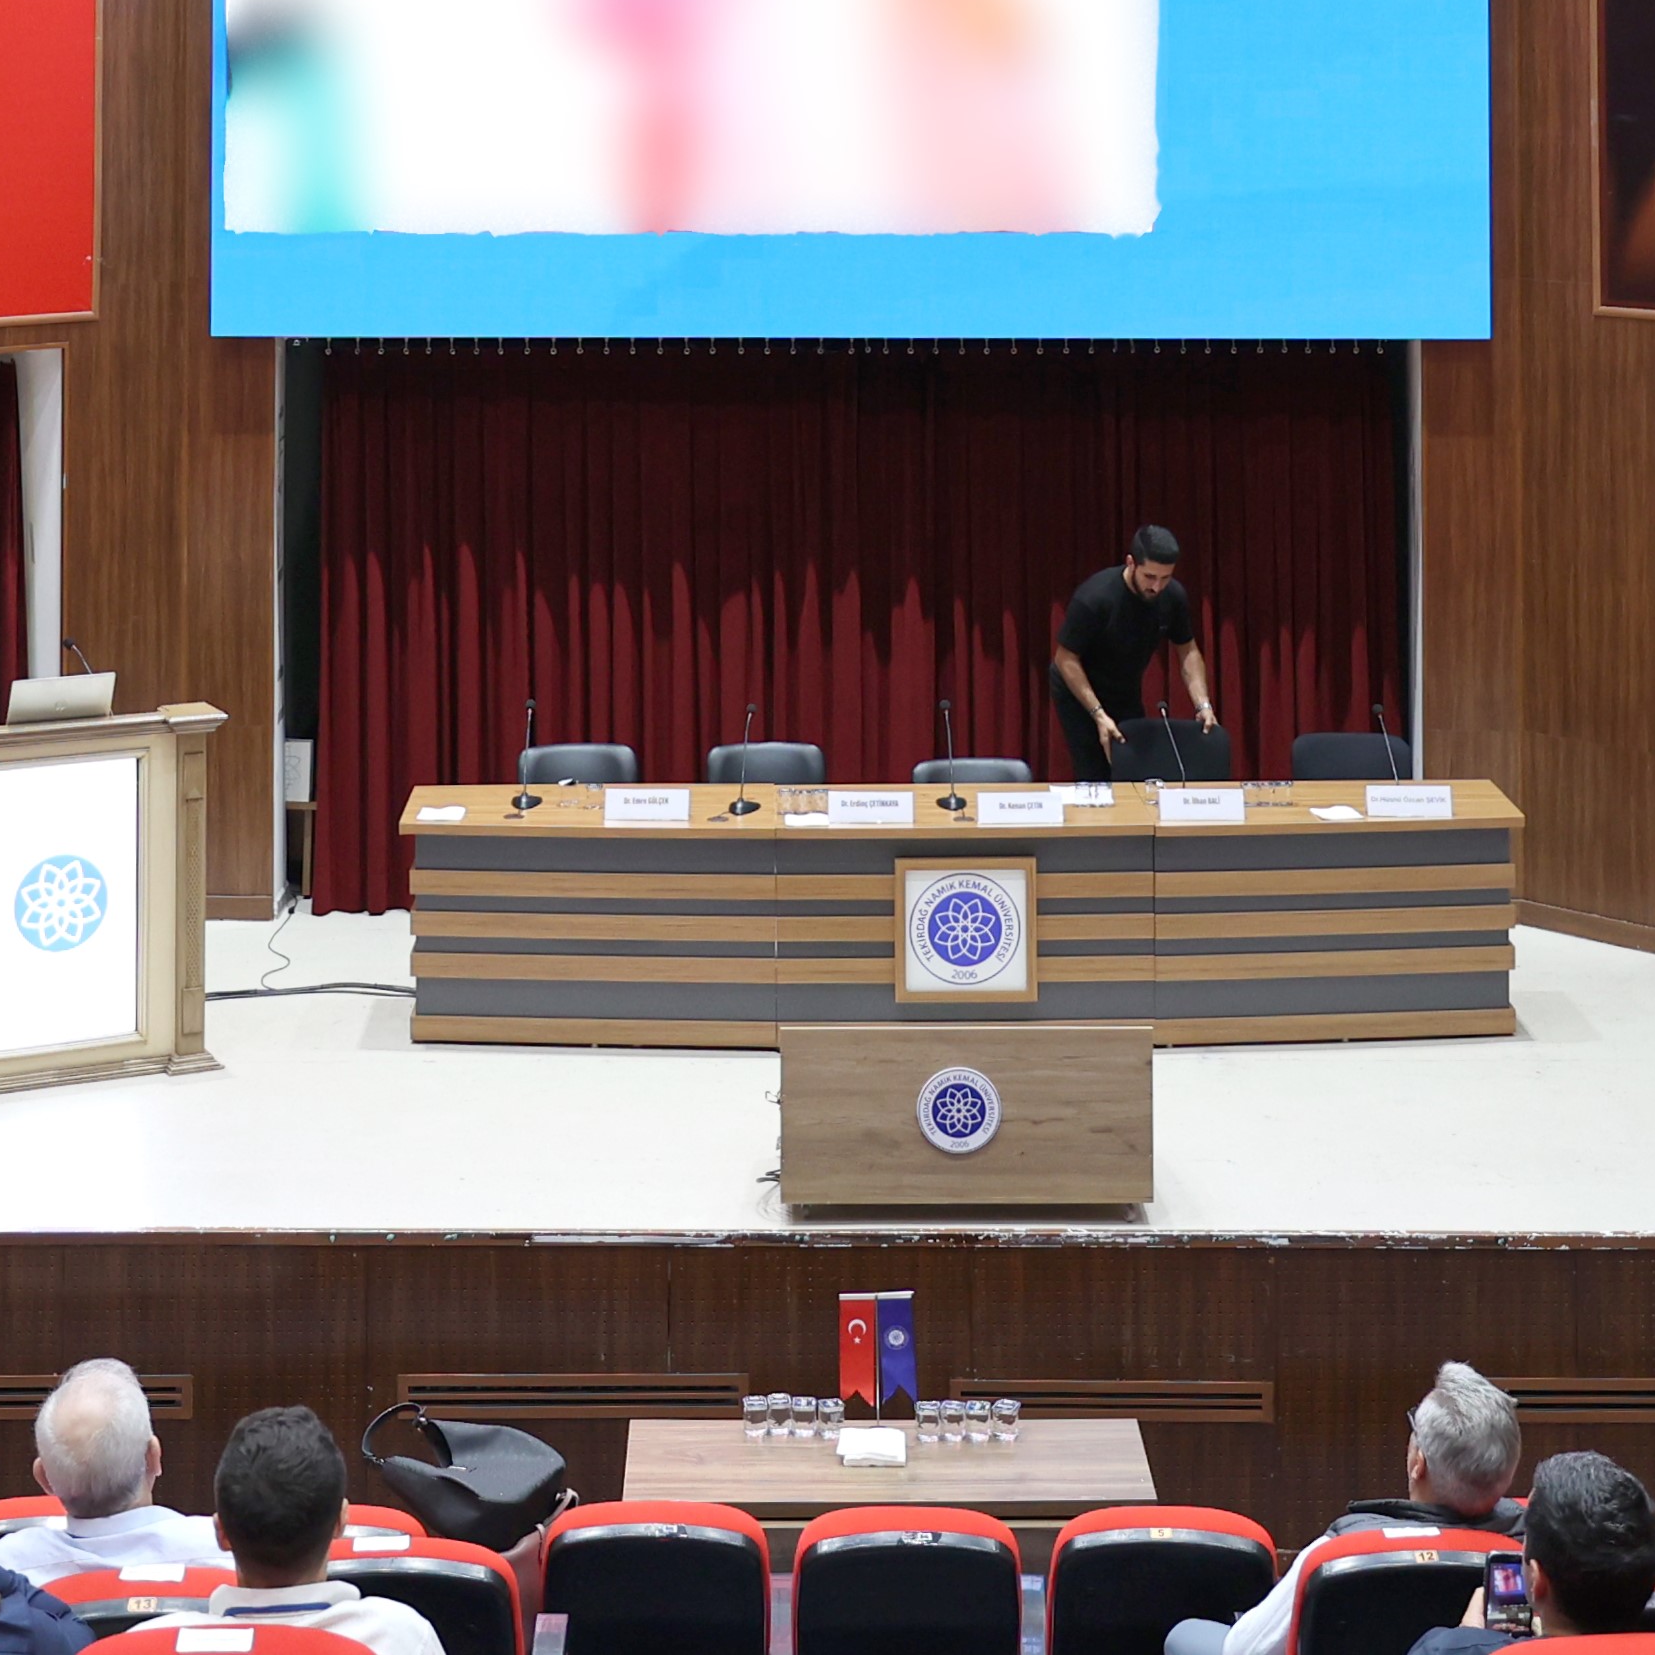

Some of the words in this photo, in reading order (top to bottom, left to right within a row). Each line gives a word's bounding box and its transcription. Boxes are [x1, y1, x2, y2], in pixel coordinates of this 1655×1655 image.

[924, 880, 957, 908] NAMIK
[958, 879, 993, 897] KEMAL
[993, 893, 1014, 963] ÜNİVERSİTESİ
[916, 909, 935, 962] TEKİRDAĞ
[951, 969, 978, 980] 2006
[929, 1075, 951, 1096] NAMIK
[952, 1074, 978, 1087] KEMAL
[950, 1140, 970, 1148] 2006
[1158, 1528, 1164, 1537] 5
[1419, 1551, 1435, 1561] 12
[134, 1599, 151, 1610] 13
